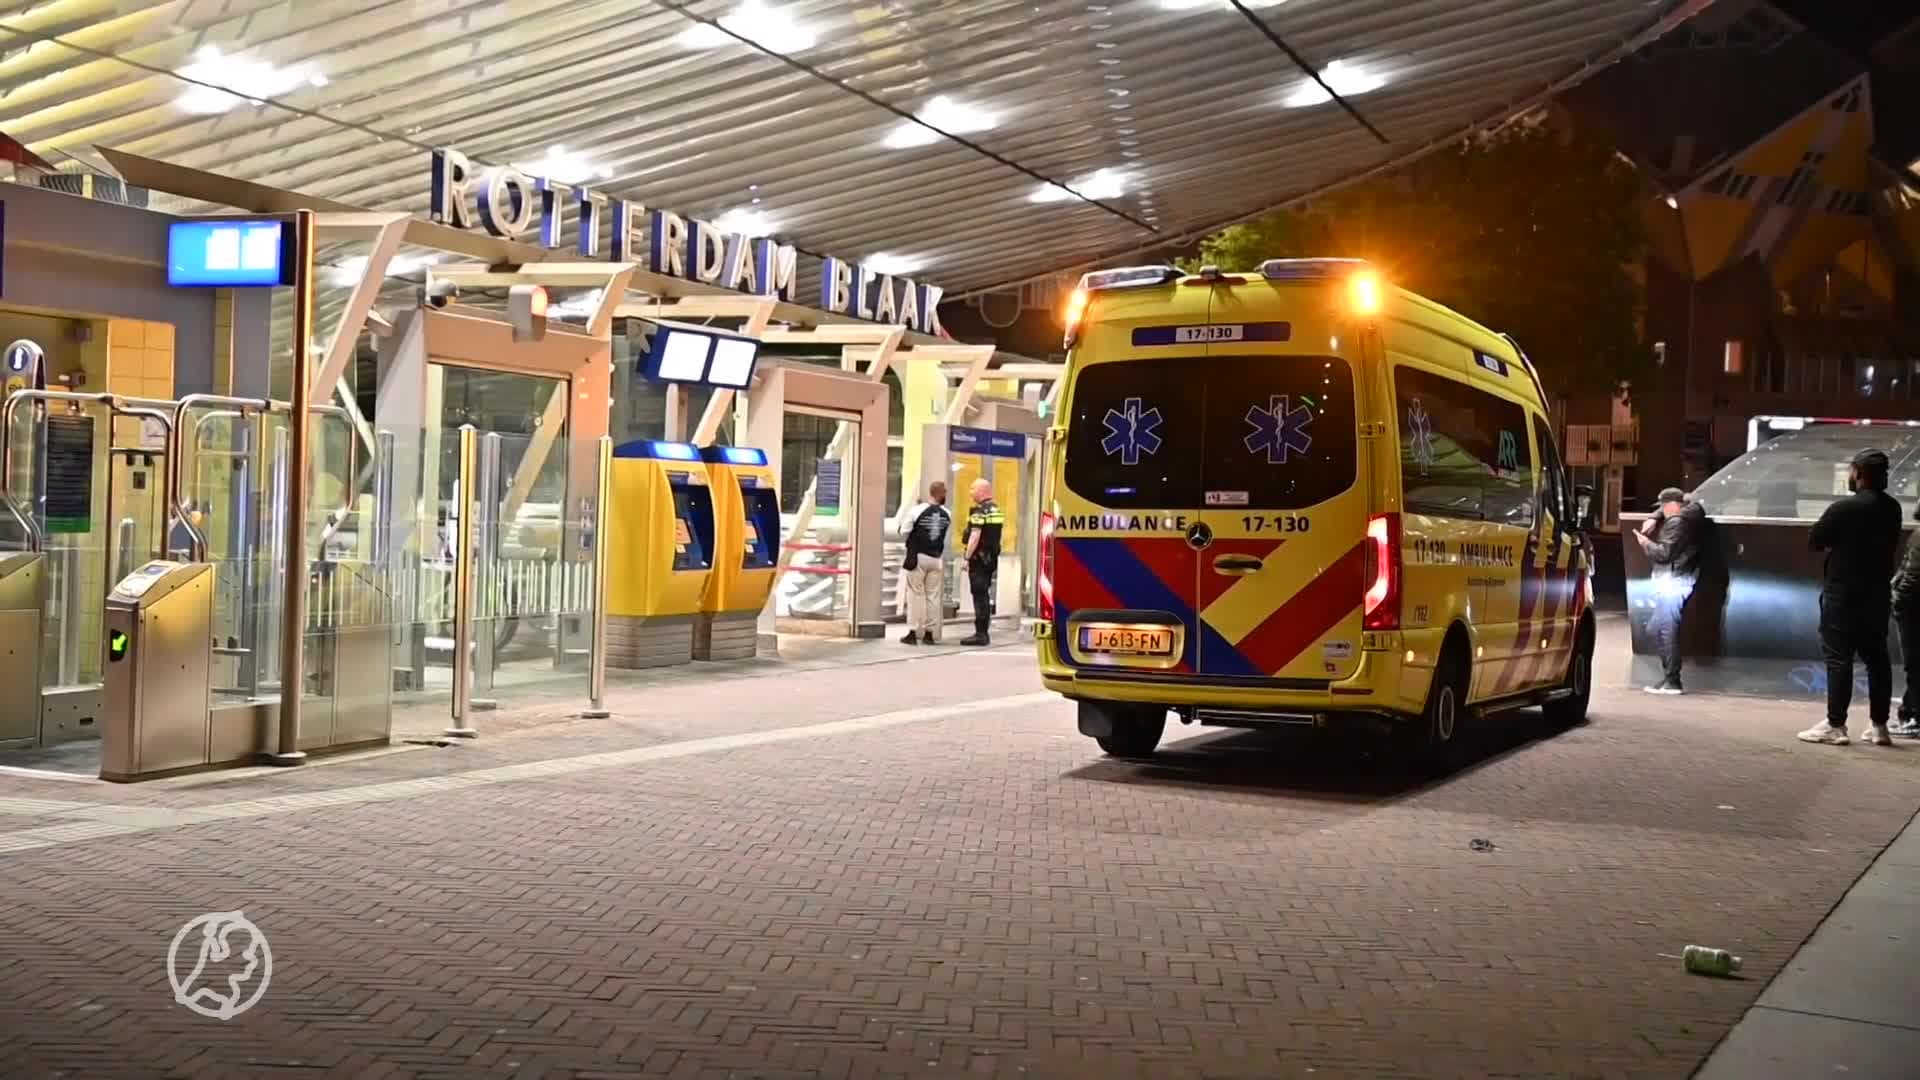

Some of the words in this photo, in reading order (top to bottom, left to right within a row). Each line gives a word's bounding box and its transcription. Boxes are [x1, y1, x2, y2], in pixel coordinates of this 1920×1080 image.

[432, 148, 797, 302] ROTTERDAM
[823, 256, 944, 336] BLAAK
[1187, 327, 1233, 340] 17-130
[1056, 515, 1187, 531] AMBULANCE
[1242, 515, 1310, 533] 17-130
[1458, 542, 1514, 568] AMBULANCE
[1095, 631, 1161, 650] J-613-FN
